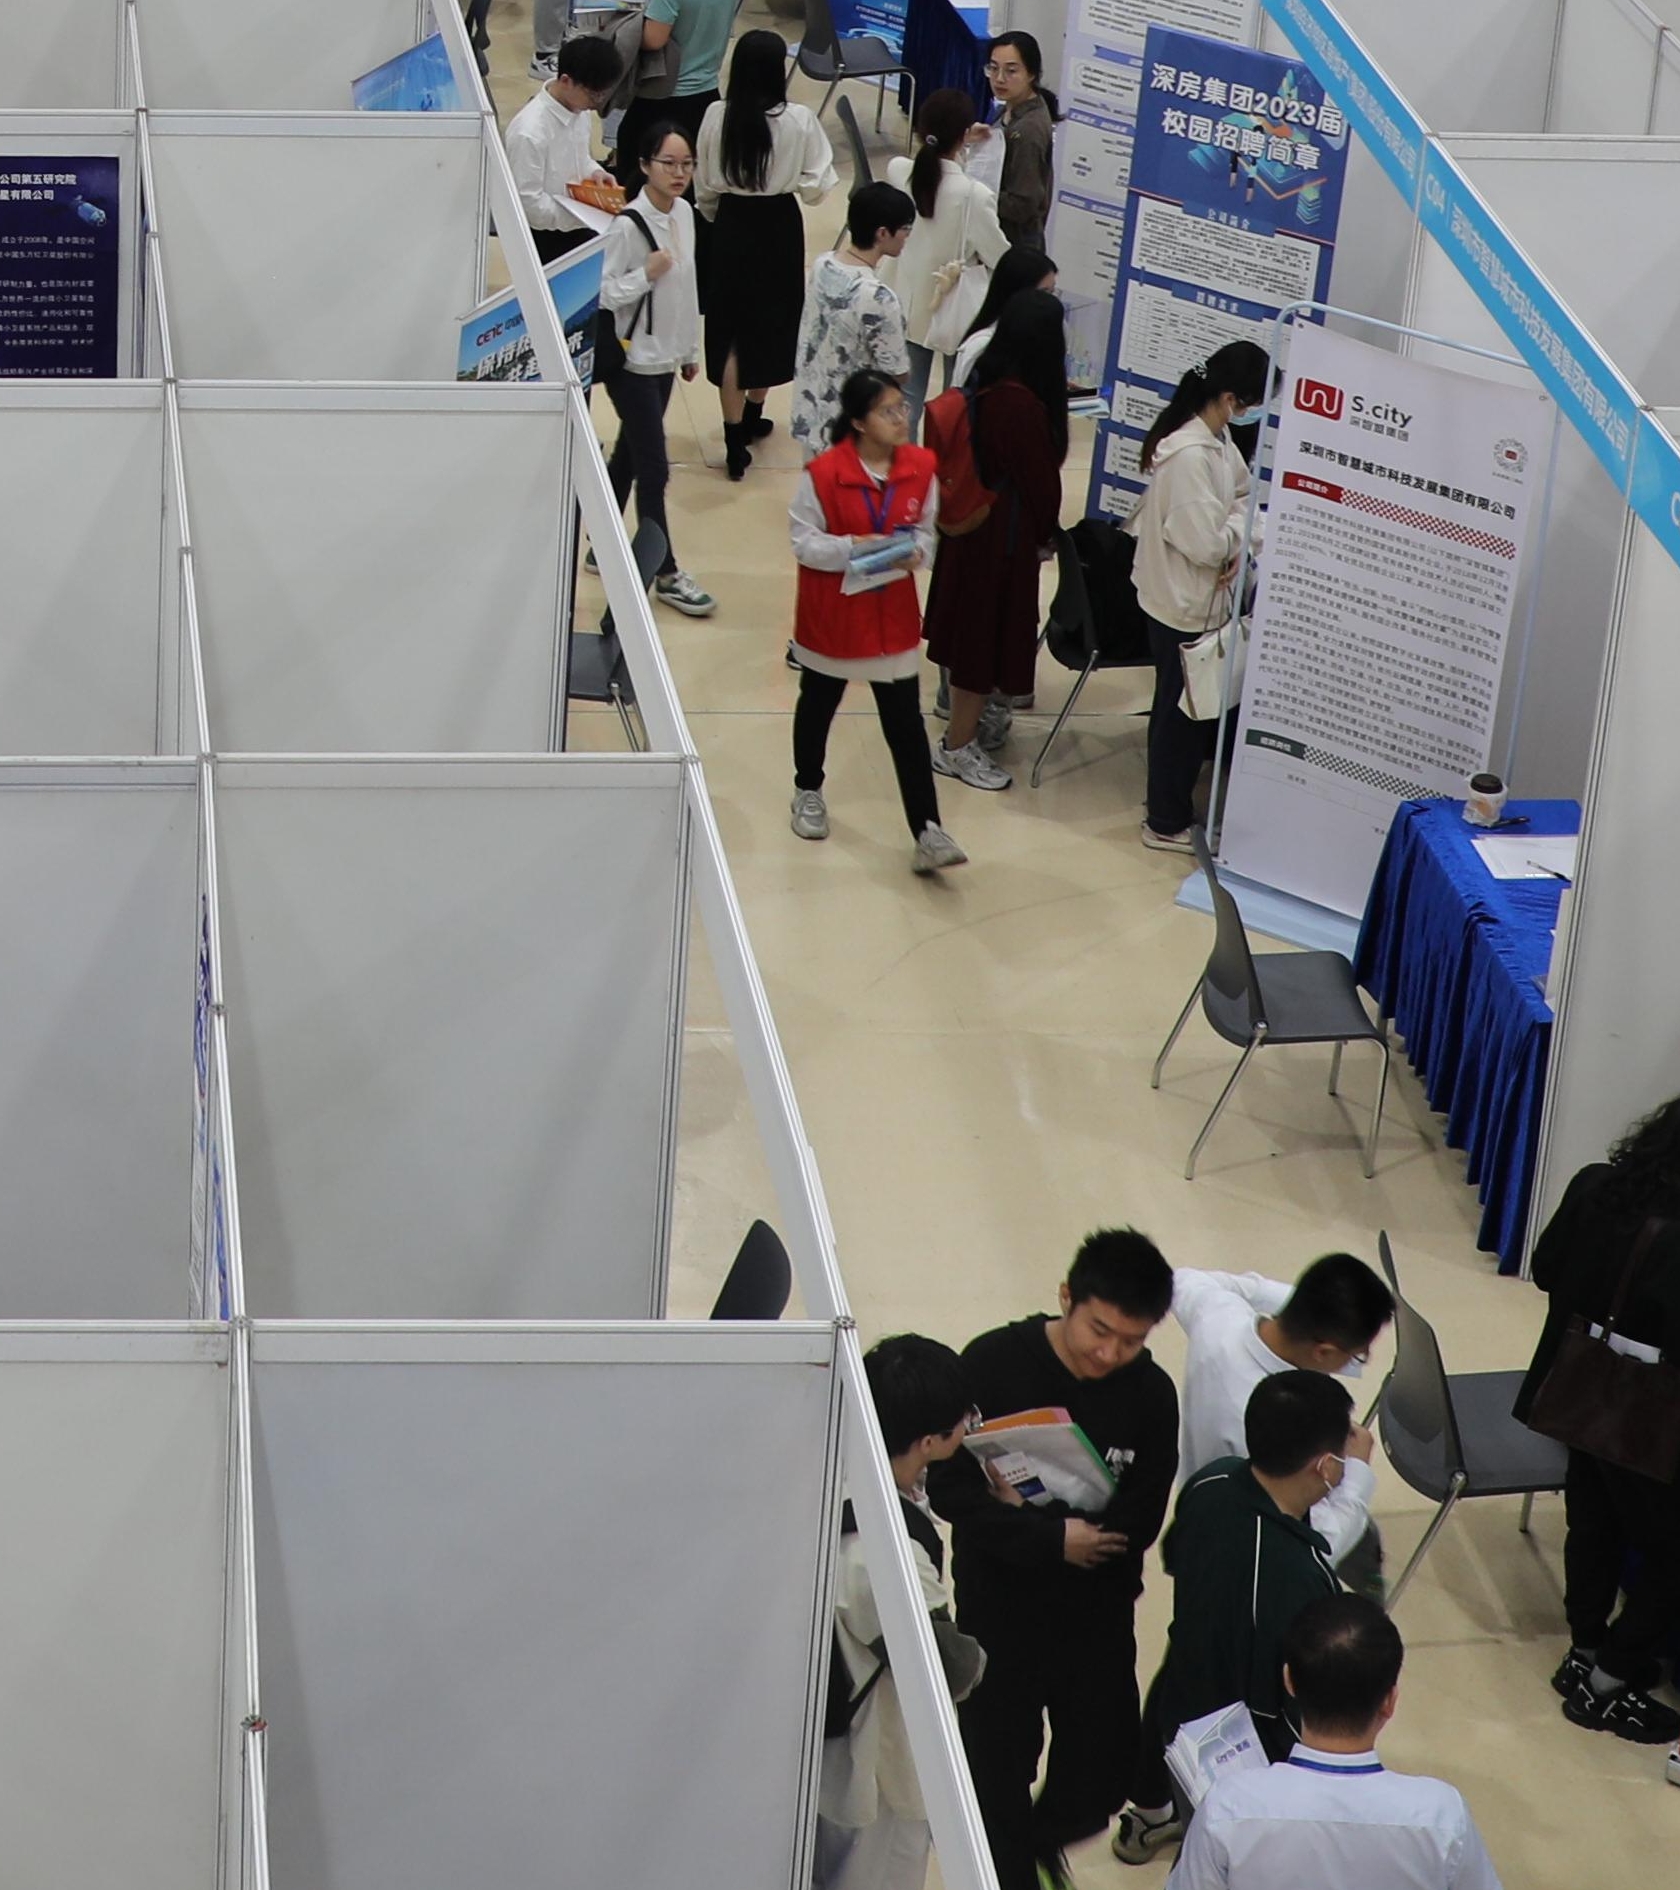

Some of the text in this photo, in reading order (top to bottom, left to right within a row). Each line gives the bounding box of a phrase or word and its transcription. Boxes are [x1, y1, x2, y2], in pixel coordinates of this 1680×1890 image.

[1148, 61, 1344, 138] 深房集团2023届
[1159, 106, 1322, 173] 校园招聘简章
[1425, 172, 1446, 214] C04
[1350, 394, 1414, 430] S.city
[1298, 439, 1517, 522] 深圳市智慧城市科技发展集团有限公司
